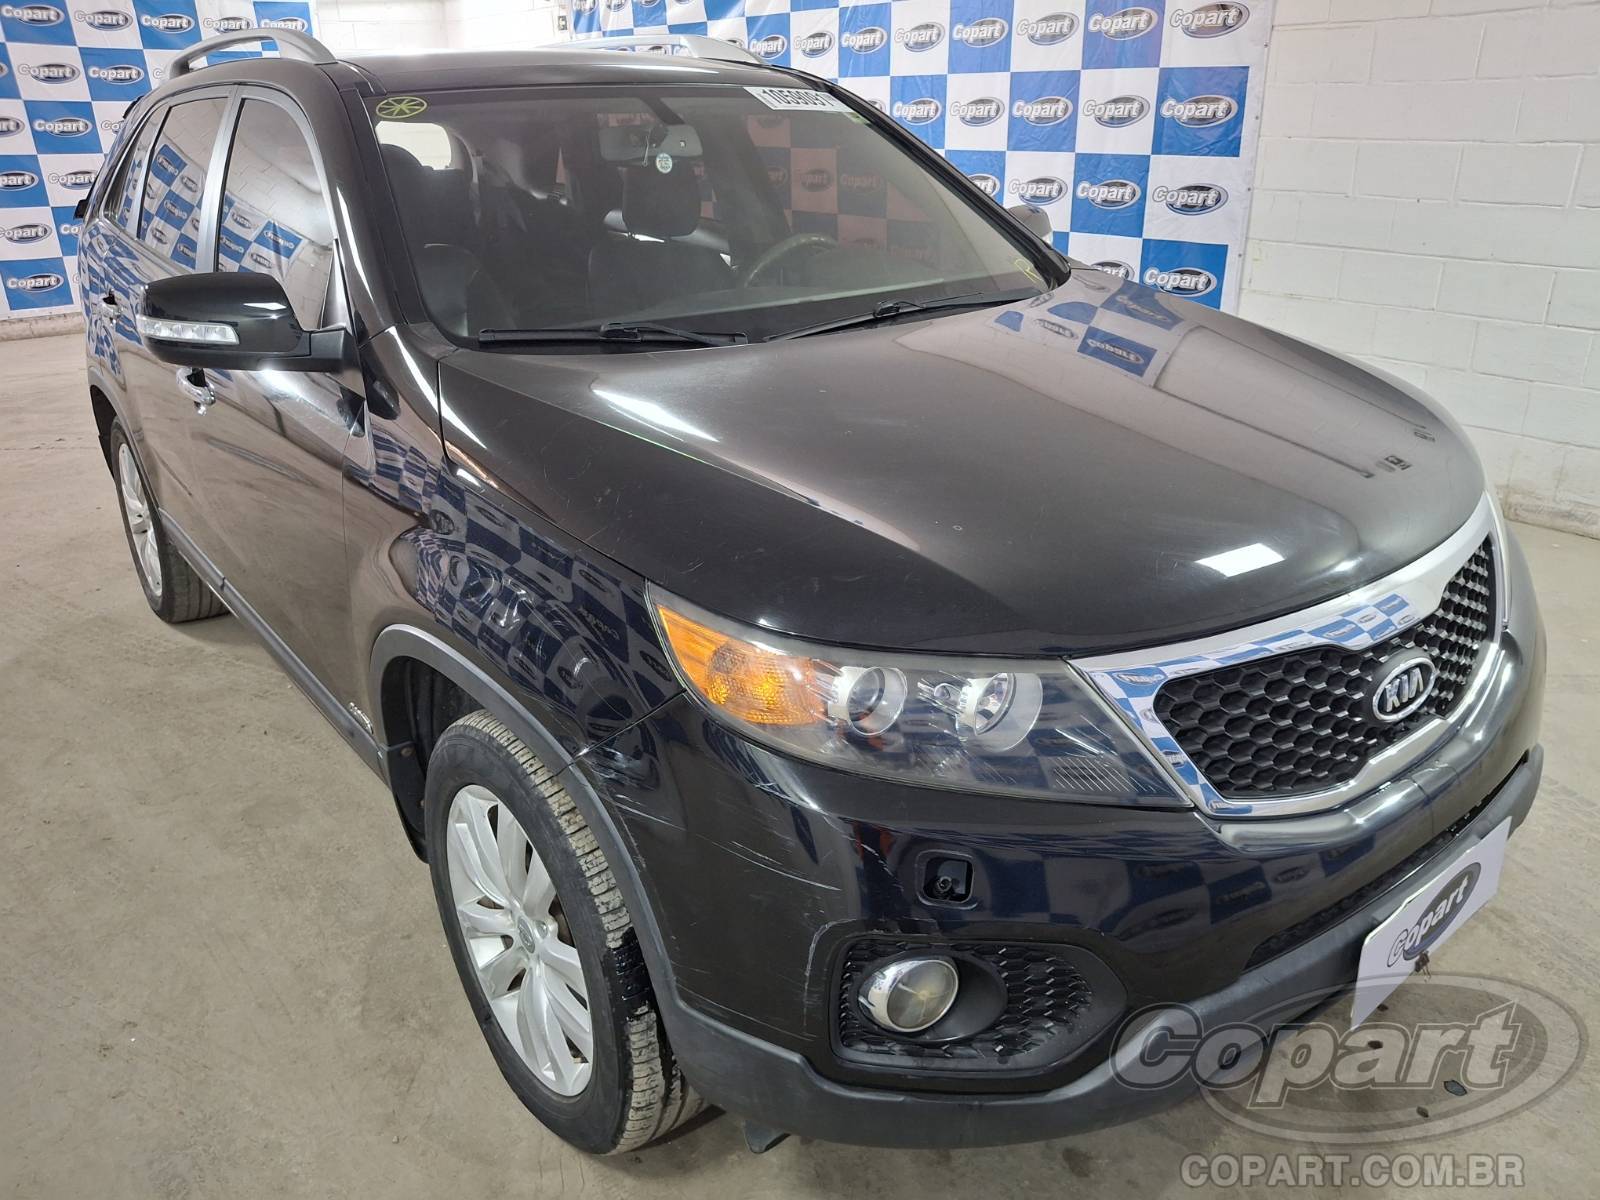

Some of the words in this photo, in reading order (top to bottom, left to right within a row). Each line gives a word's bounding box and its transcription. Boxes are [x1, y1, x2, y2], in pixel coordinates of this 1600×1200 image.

[2, 5, 58, 21] Copart
[75, 10, 125, 27] Copart
[141, 15, 189, 29] Copart
[1170, 8, 1239, 32] Copart
[203, 18, 247, 30] Copart
[1017, 17, 1072, 39] Copart
[1088, 11, 1150, 34] Copart
[842, 30, 881, 49] Copart
[895, 27, 939, 44] Copart
[953, 23, 1001, 42] Copart
[750, 39, 783, 54] Copart
[794, 36, 831, 51] Copart
[19, 63, 72, 79] Copart
[88, 66, 139, 81] Copart
[893, 102, 937, 120] Copart
[951, 101, 998, 119] Copart
[1013, 100, 1066, 120] Copart
[1083, 99, 1142, 121] Copart
[1160, 97, 1230, 122] Copart
[33, 119, 87, 134] Copart
[0, 174, 33, 187] part
[1008, 179, 1060, 199] Copart
[1077, 180, 1134, 204] Copart
[1153, 185, 1219, 207] Copart
[7, 275, 58, 290] Copart
[1144, 267, 1210, 291] Copart
[1385, 667, 1424, 712] KIA
[1387, 874, 1469, 968] Copart
